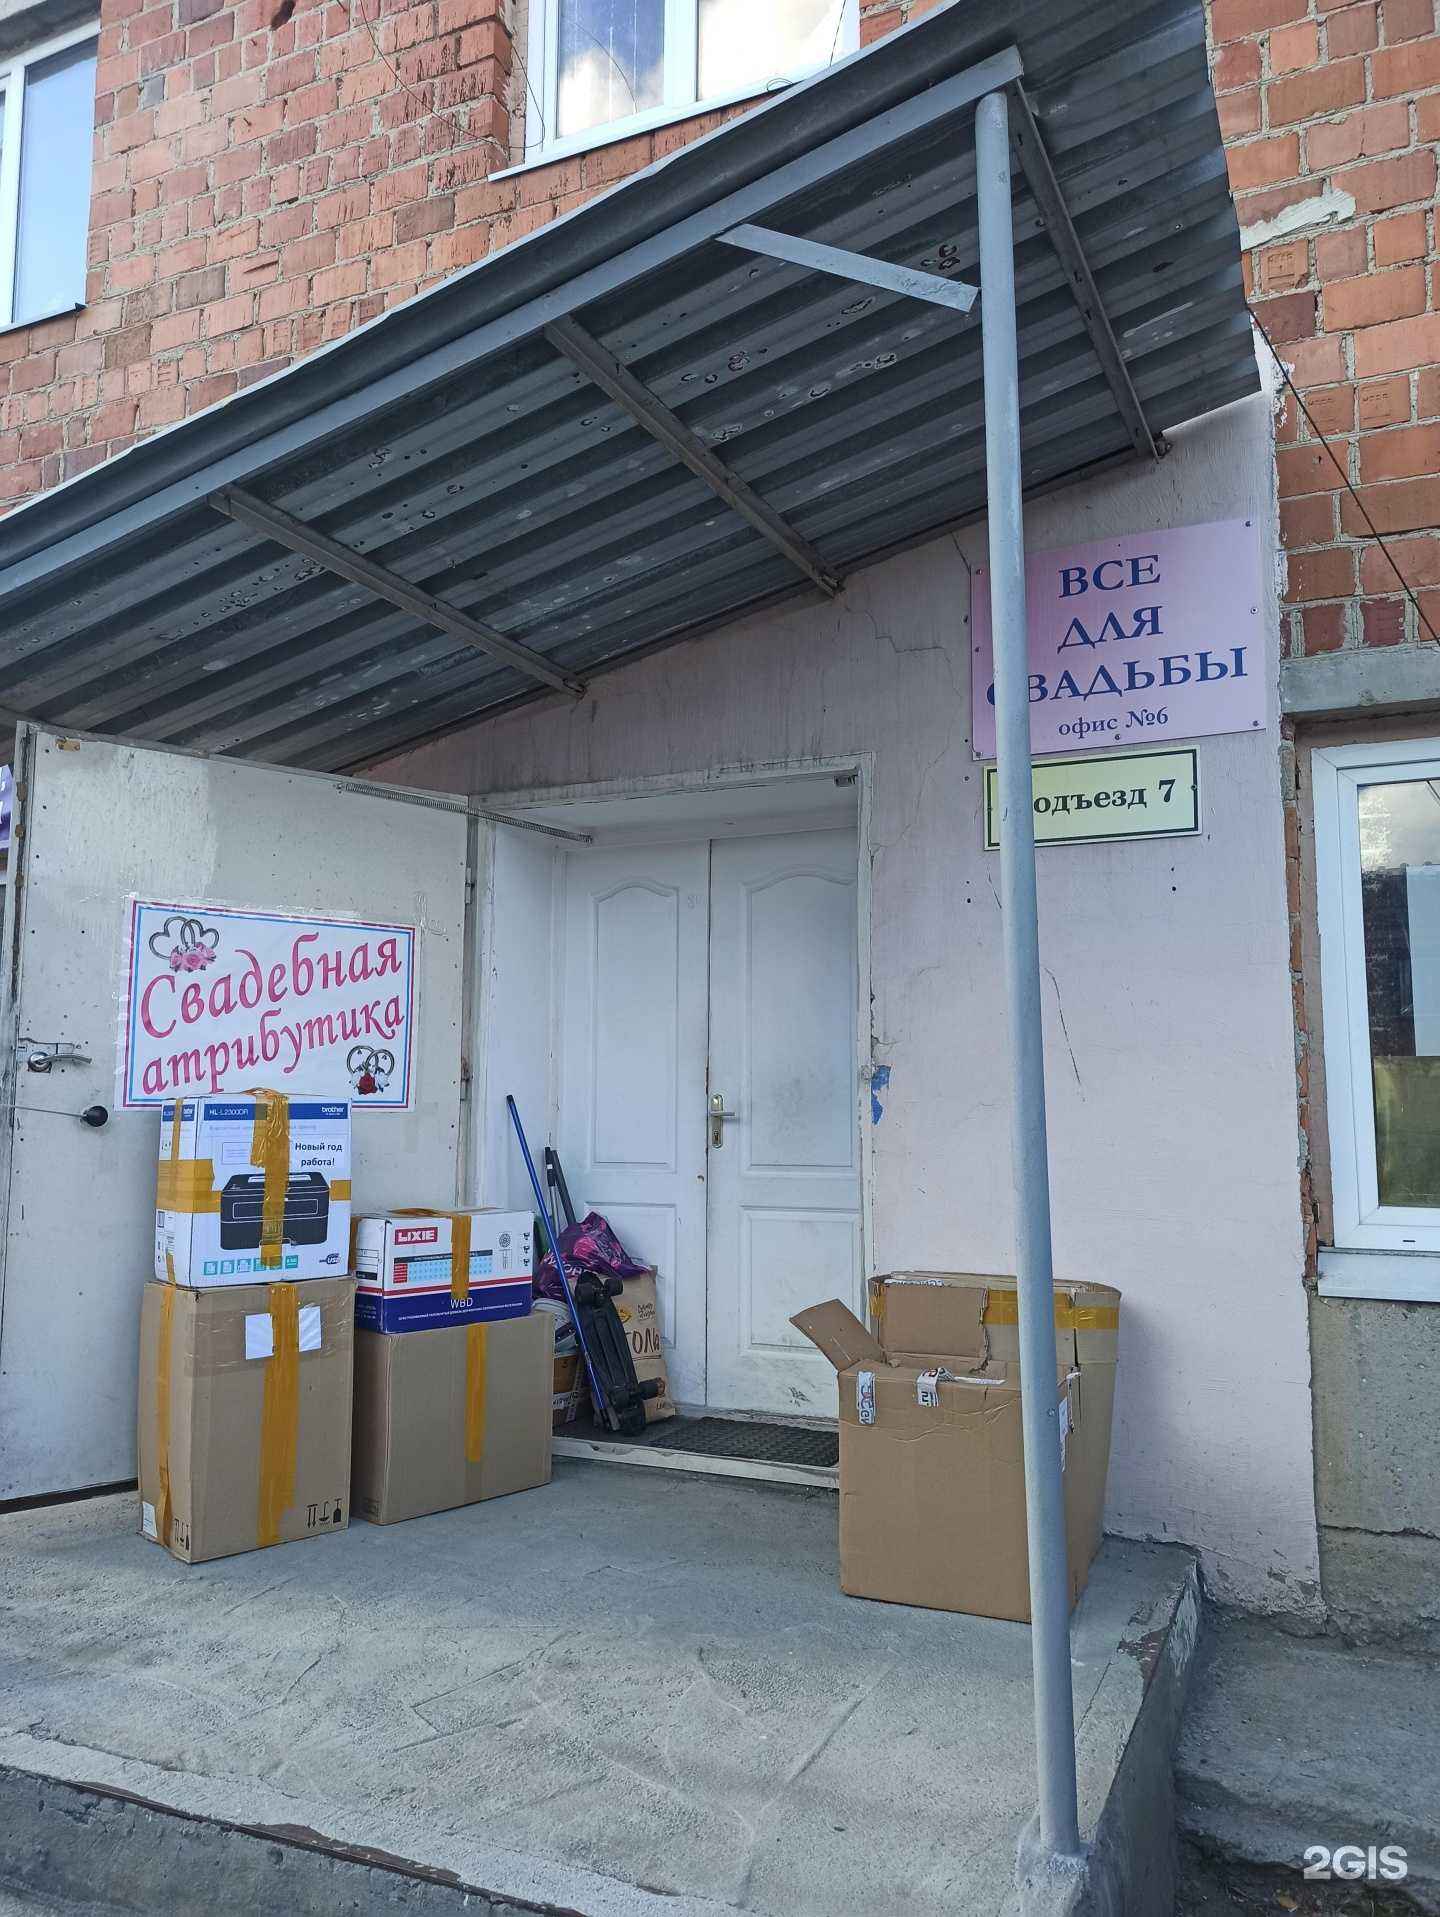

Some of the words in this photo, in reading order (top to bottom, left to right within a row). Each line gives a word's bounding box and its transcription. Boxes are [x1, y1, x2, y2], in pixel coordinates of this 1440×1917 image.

[1058, 554, 1161, 599] ВСЕ
[1057, 605, 1164, 655] ДЛЯ
[1058, 717, 1118, 740] офис
[1125, 706, 1169, 730] №6
[1033, 785, 1148, 816] одъезд
[1158, 778, 1176, 804] 7
[140, 932, 403, 1039] Свадебная
[142, 995, 405, 1095] атрибутика
[321, 1105, 345, 1114] brother
[295, 1140, 325, 1151] Новый
[327, 1144, 343, 1152] год
[301, 1156, 335, 1167] работа!
[398, 1230, 436, 1243] LIXIE
[450, 1297, 474, 1309] WBD
